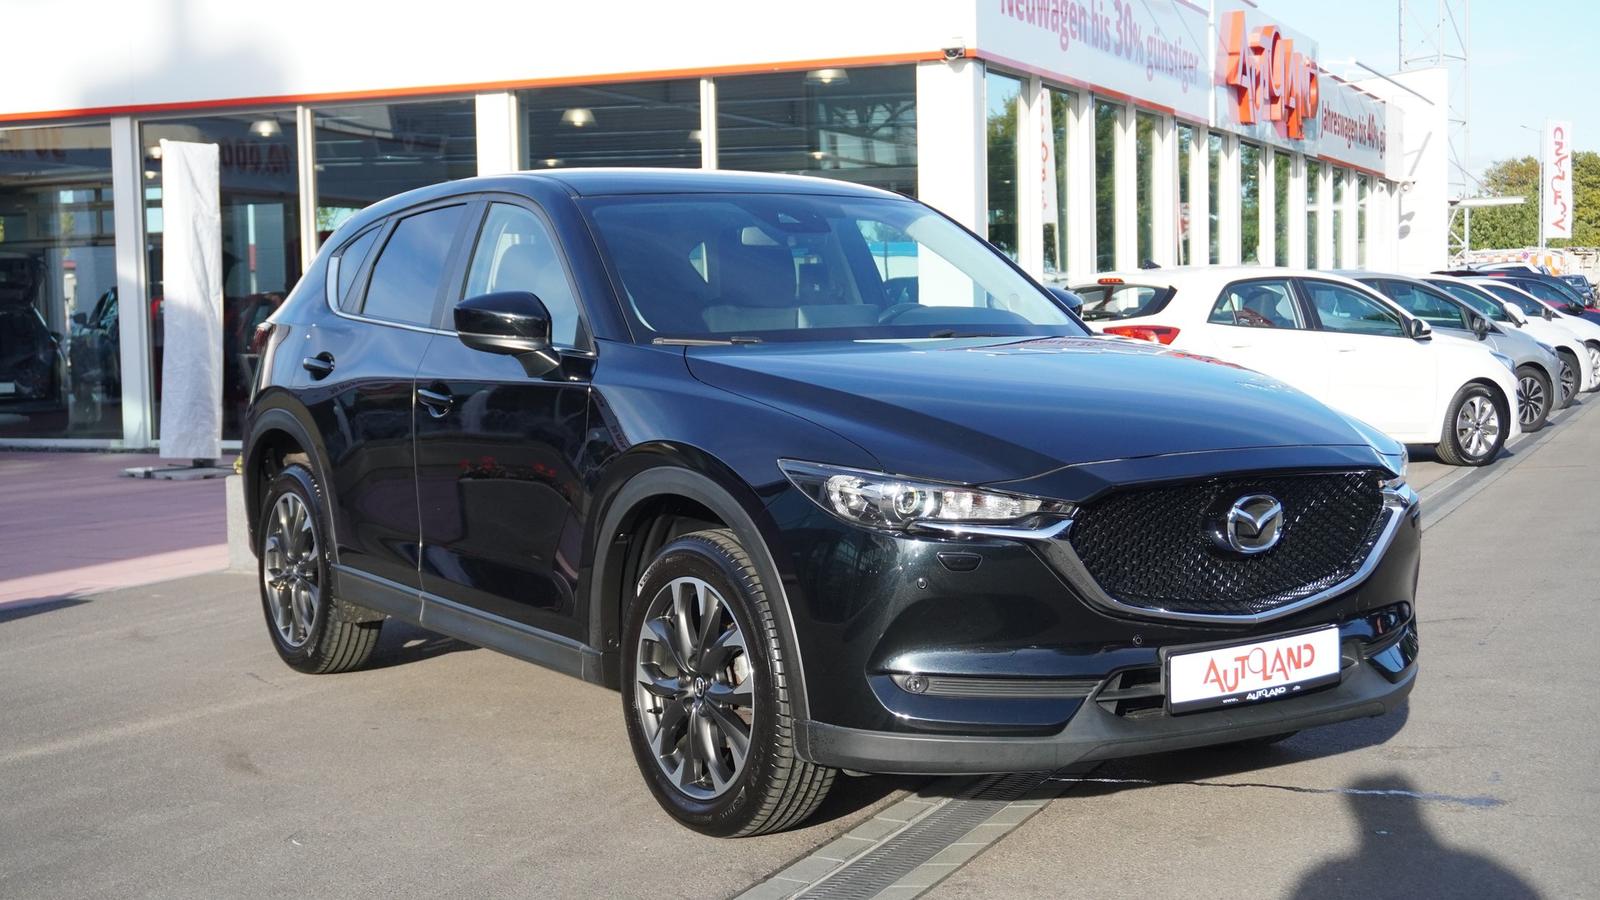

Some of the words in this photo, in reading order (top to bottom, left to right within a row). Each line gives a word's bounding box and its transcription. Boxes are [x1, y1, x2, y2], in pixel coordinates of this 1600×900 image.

[1091, 0, 1110, 52] bis
[1114, 0, 1144, 65] 30%
[1146, 26, 1199, 94] günstiger
[1320, 100, 1358, 149] Jahreswagen
[1358, 114, 1366, 146] bis
[1203, 643, 1315, 693] AUTOLAND
[1246, 686, 1287, 700] AUTOLAND
